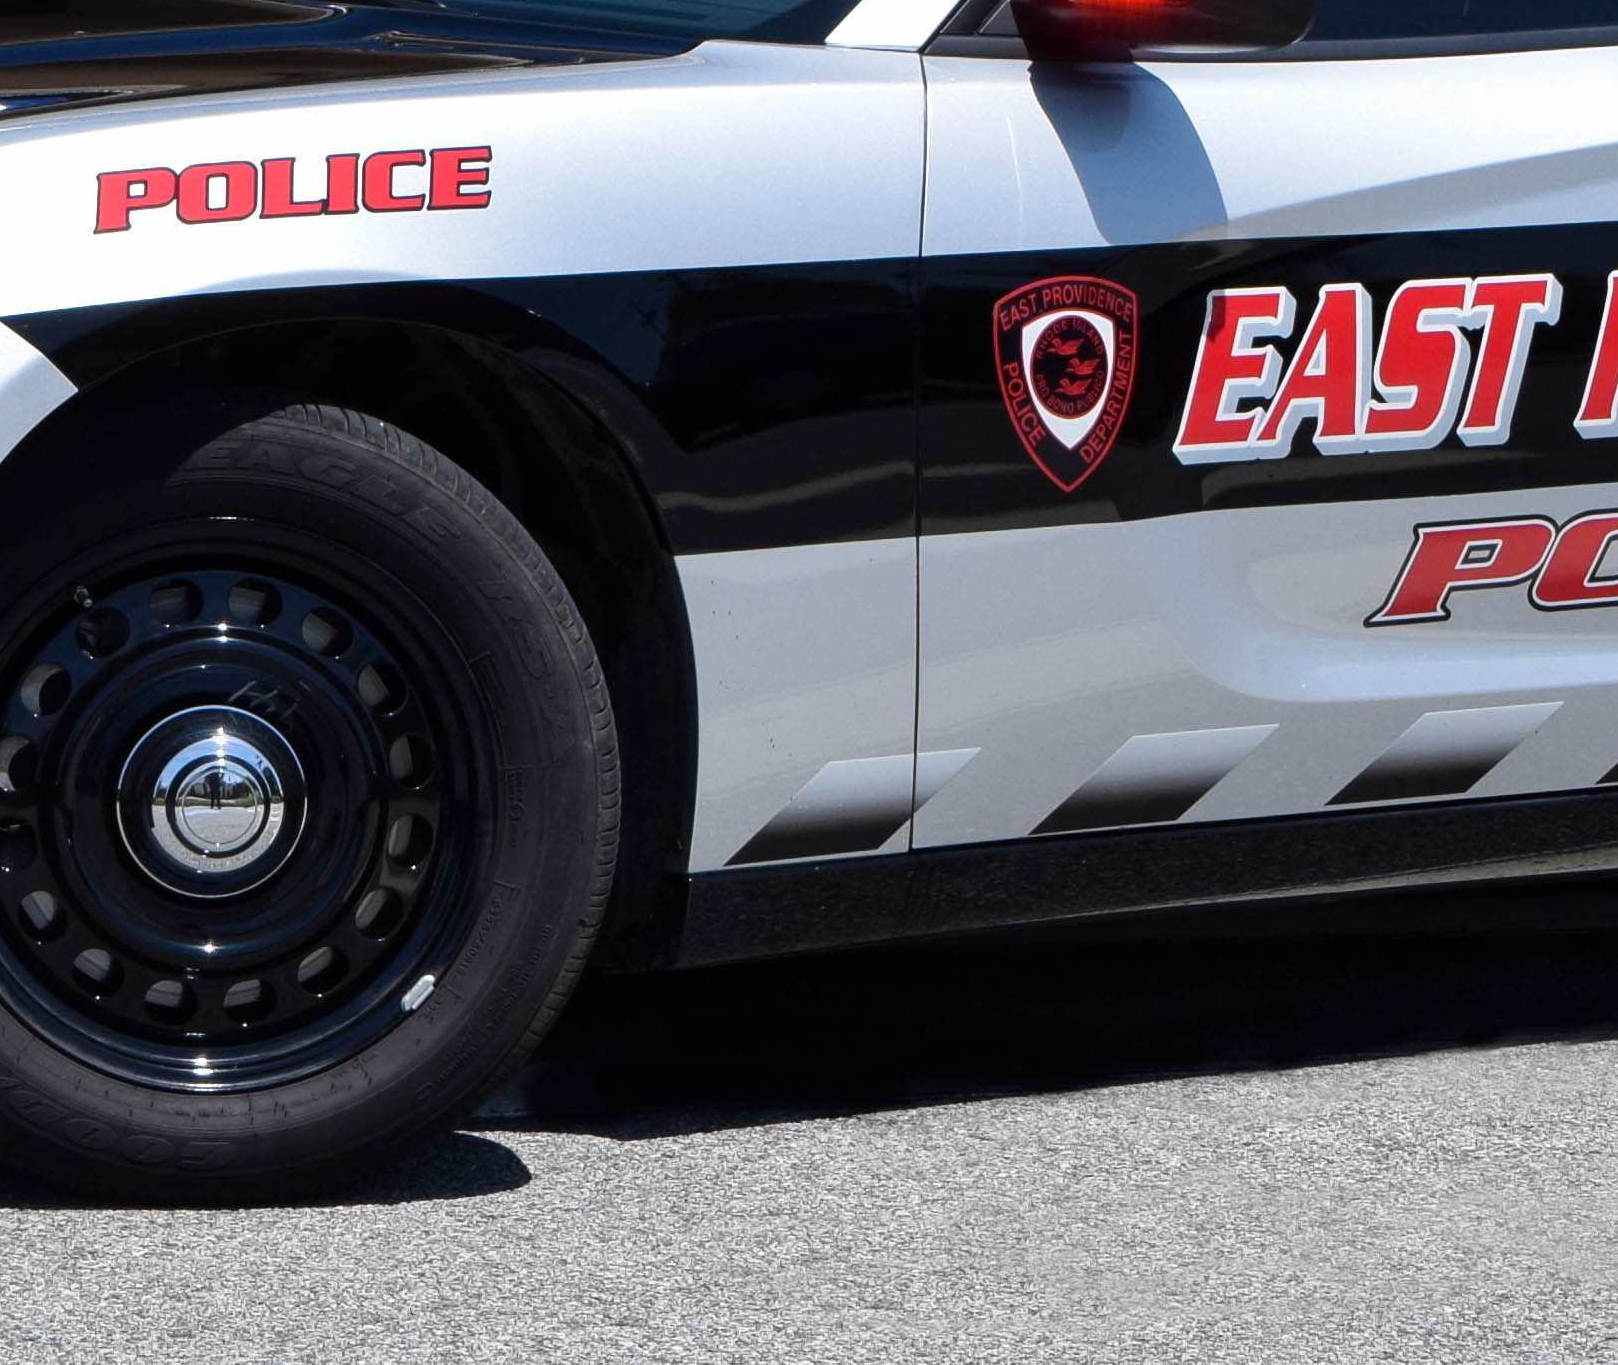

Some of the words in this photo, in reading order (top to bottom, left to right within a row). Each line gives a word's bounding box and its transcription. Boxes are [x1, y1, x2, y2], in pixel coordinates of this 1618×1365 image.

[93, 145, 492, 235] POLICE
[999, 294, 1037, 332] EAST
[1041, 285, 1133, 324] PROVIDENCE
[1002, 361, 1047, 447] POLICE
[1078, 330, 1133, 463] DEPARTMENT
[1172, 273, 1562, 464] EAST
